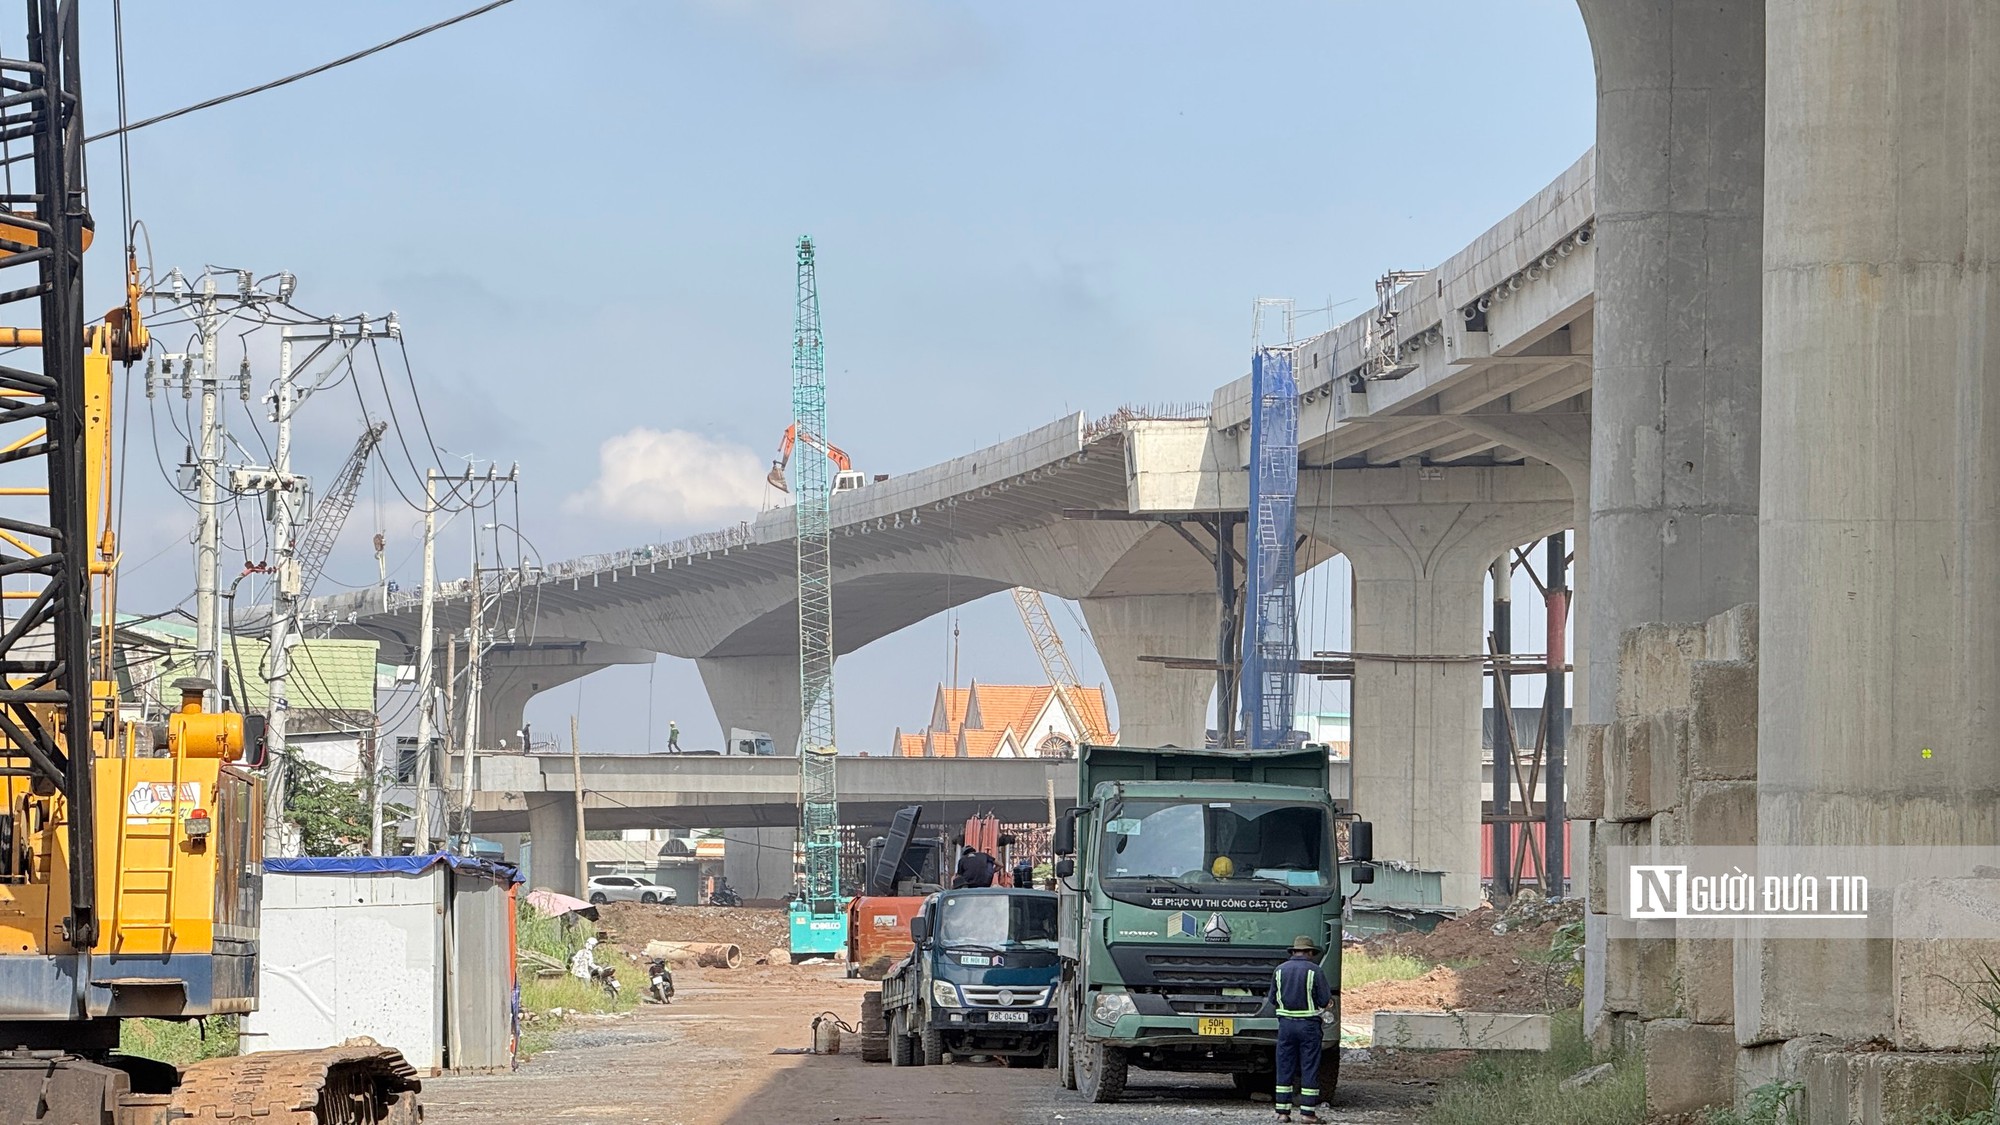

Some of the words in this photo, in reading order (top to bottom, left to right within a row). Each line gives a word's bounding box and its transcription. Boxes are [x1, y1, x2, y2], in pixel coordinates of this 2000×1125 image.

[1151, 897, 1163, 906] XE
[1165, 898, 1190, 908] PHỤC
[1191, 898, 1204, 909] VỤ
[1205, 899, 1220, 908] THI
[1221, 897, 1247, 908] CÔNG
[1208, 1018, 1224, 1027] 50H
